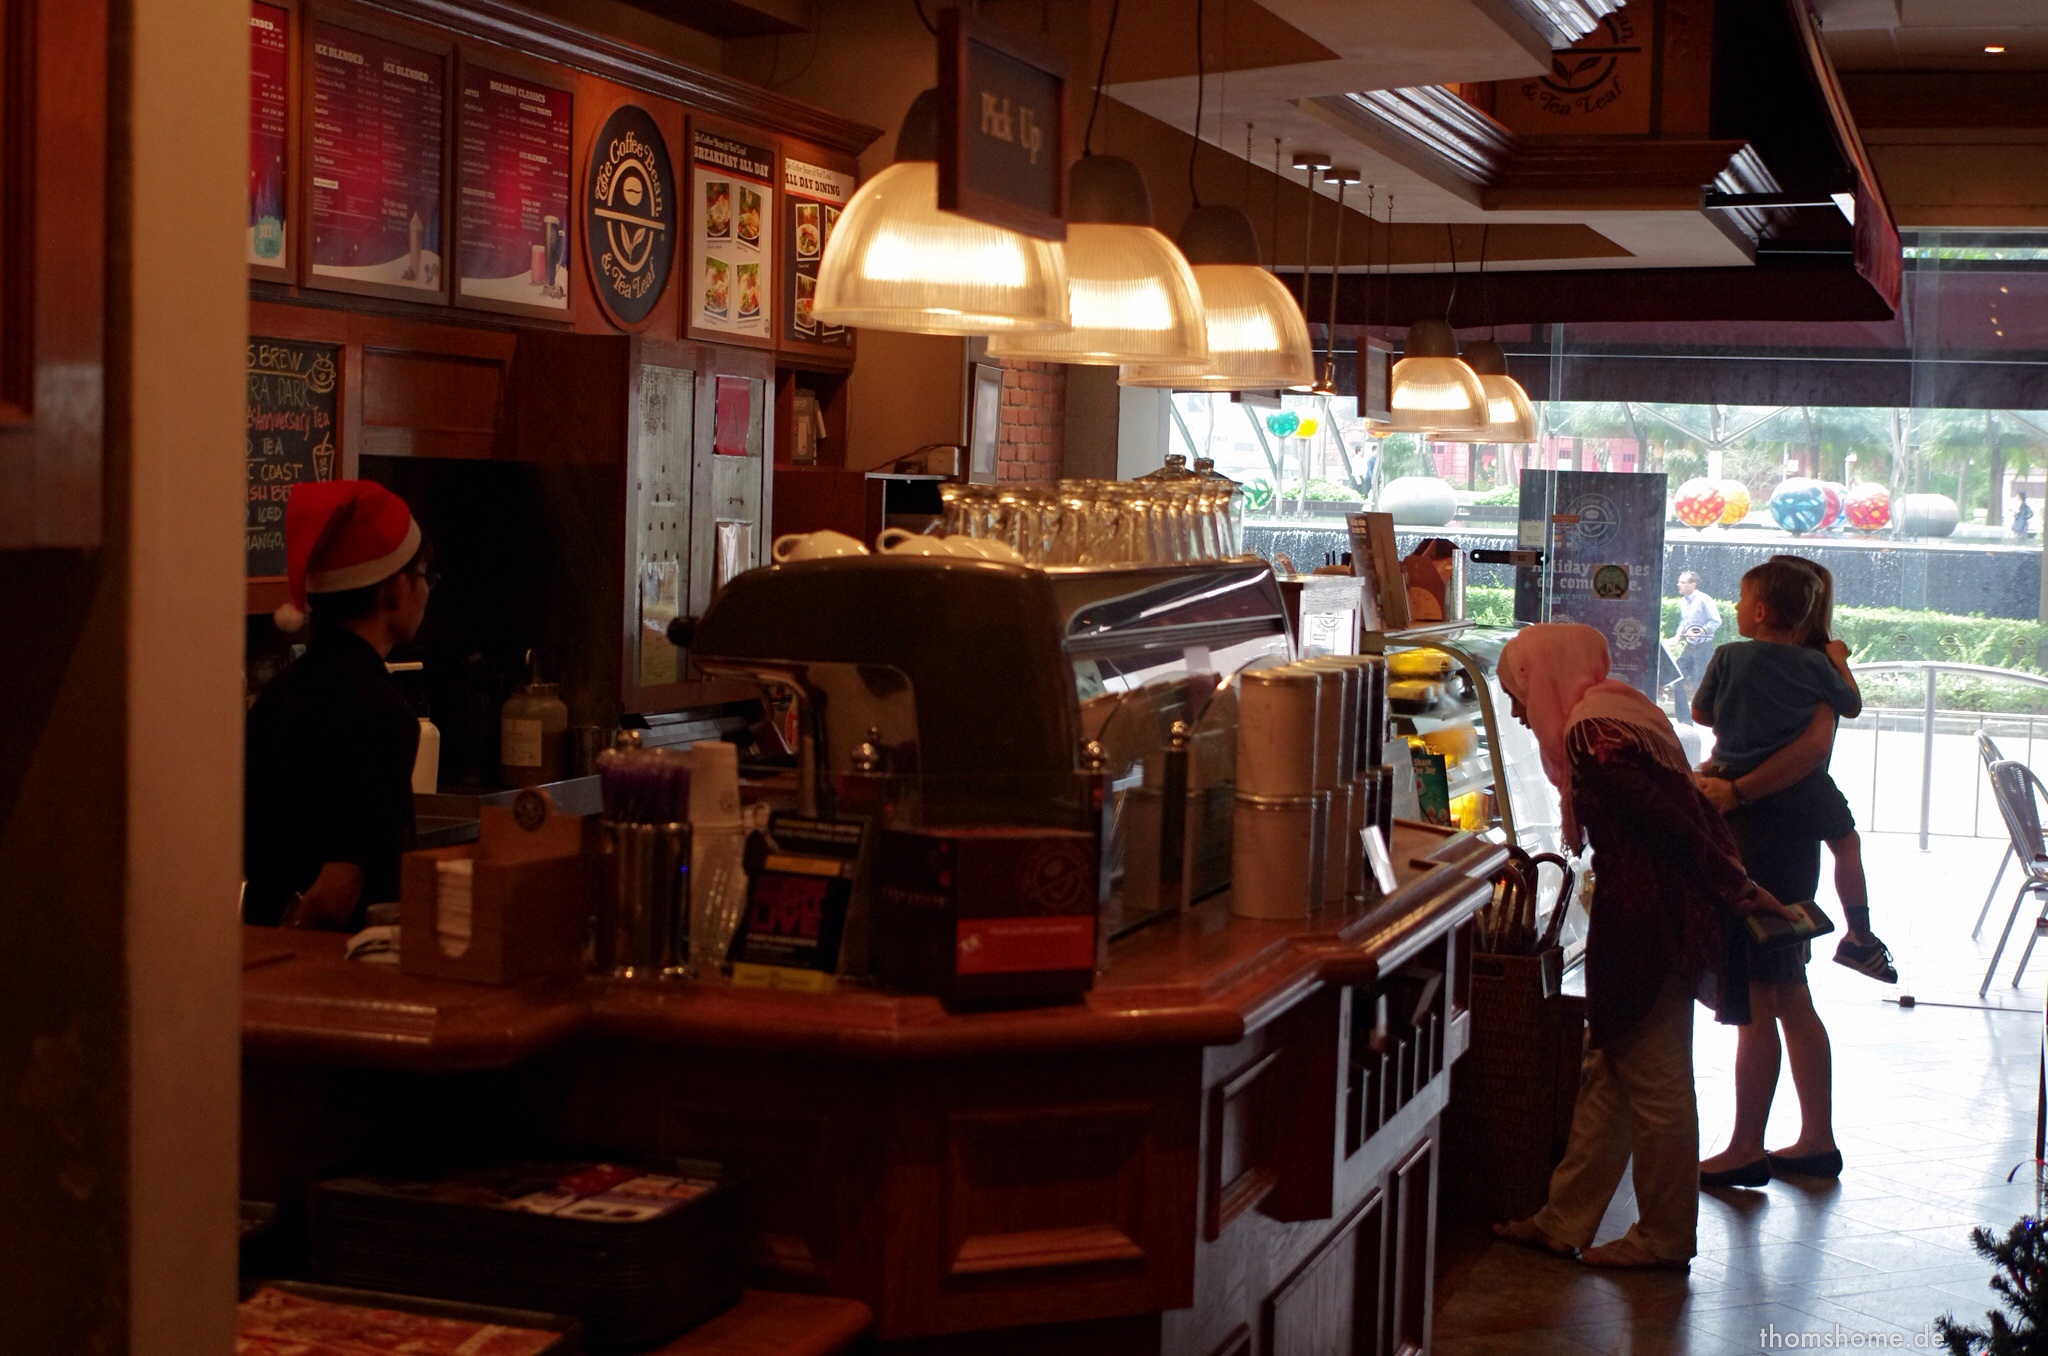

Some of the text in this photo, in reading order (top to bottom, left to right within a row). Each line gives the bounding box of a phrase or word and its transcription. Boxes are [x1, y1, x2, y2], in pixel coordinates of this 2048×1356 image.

[314, 43, 364, 65] ICE BLENDED
[383, 62, 429, 83] ICE BLENDED
[489, 80, 546, 104] HOLIDAY CLASSICS
[1540, 91, 1570, 115] Tea
[1575, 75, 1622, 114] Leaf
[981, 91, 1043, 165] Pick Up
[595, 160, 613, 200] The
[610, 131, 644, 164] Coffee
[643, 144, 664, 217] Bean
[694, 145, 769, 178] BREAKFAST ALL DAY
[785, 172, 841, 197] ALL DAY DINING
[601, 252, 656, 299] & Tea Leaf
[259, 344, 303, 371] BREW
[278, 377, 311, 408] DARK
[261, 437, 284, 456] TEA
[261, 462, 303, 482] COAST
[257, 506, 282, 523] ICED
